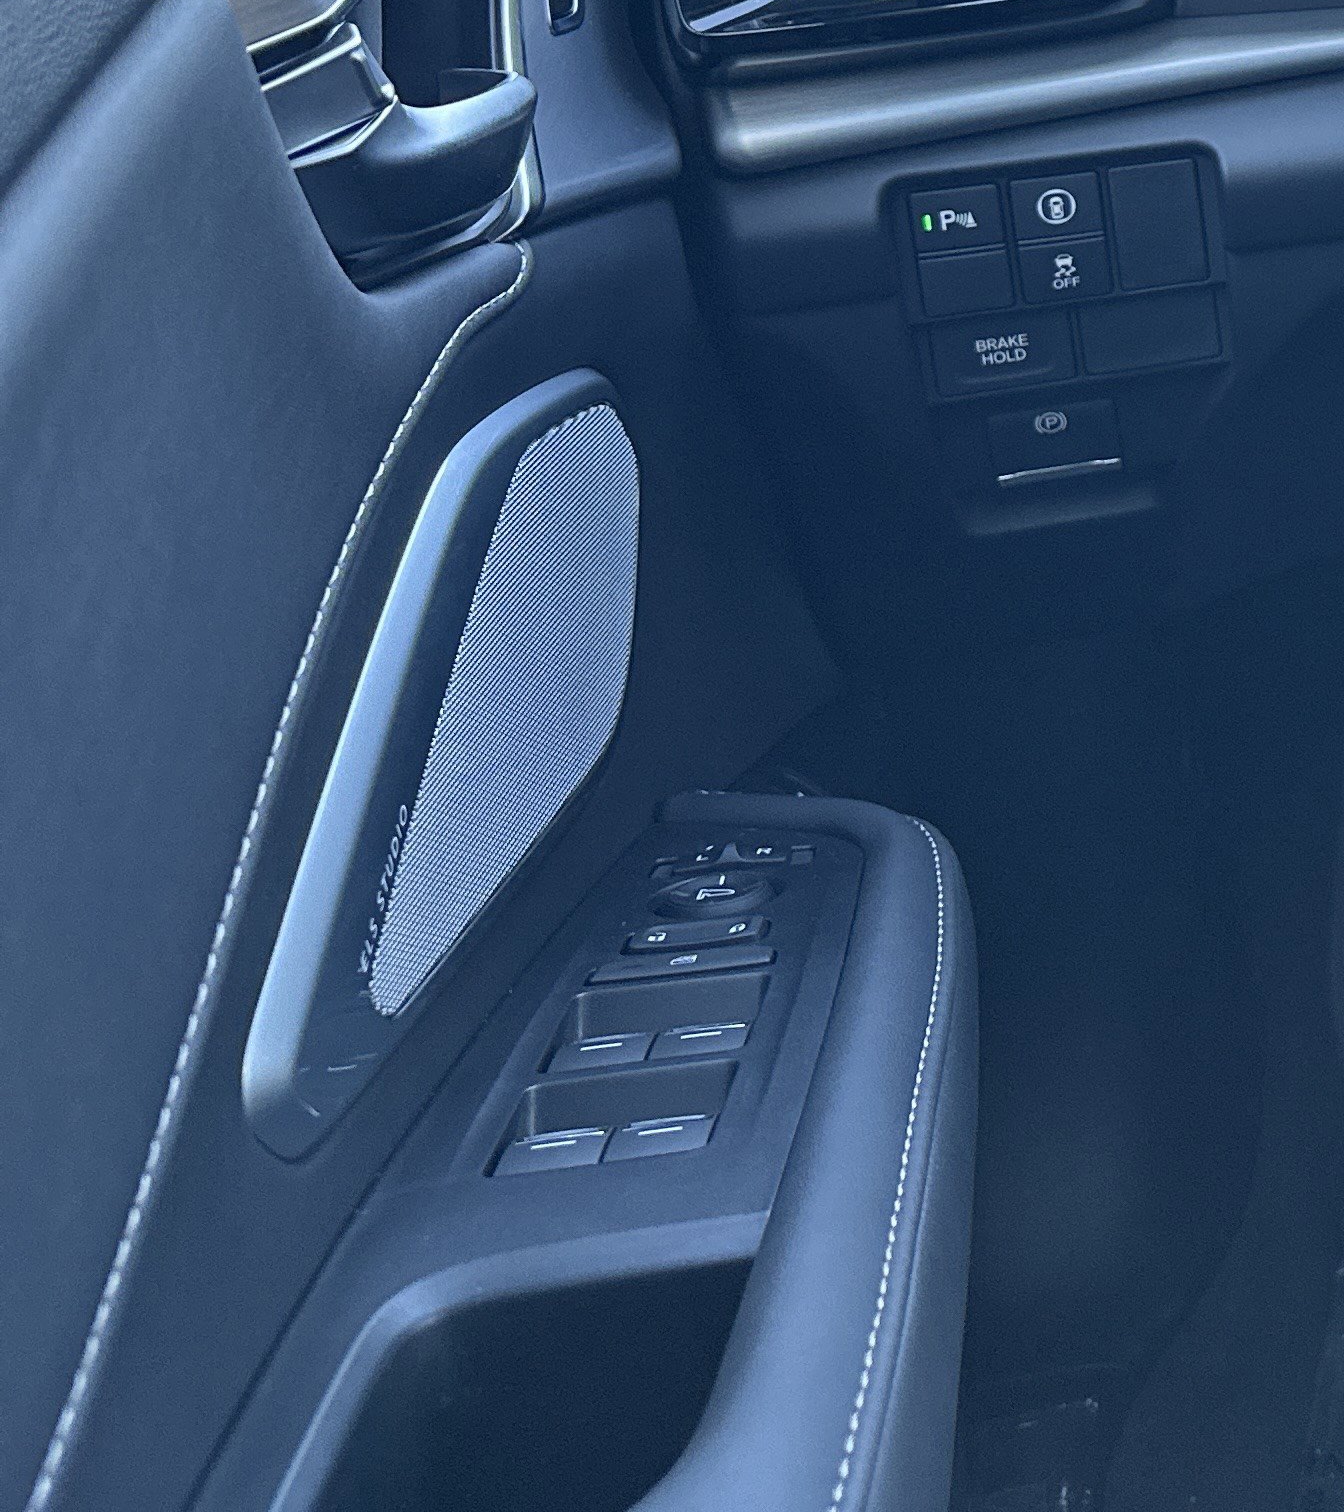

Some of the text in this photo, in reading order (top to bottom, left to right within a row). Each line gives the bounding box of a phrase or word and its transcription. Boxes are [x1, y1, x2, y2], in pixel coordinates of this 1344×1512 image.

[1052, 275, 1081, 290] OFF
[975, 333, 1030, 354] BRAKE
[981, 348, 1027, 366] HOLD
[358, 804, 408, 973] ELS STUDIO
